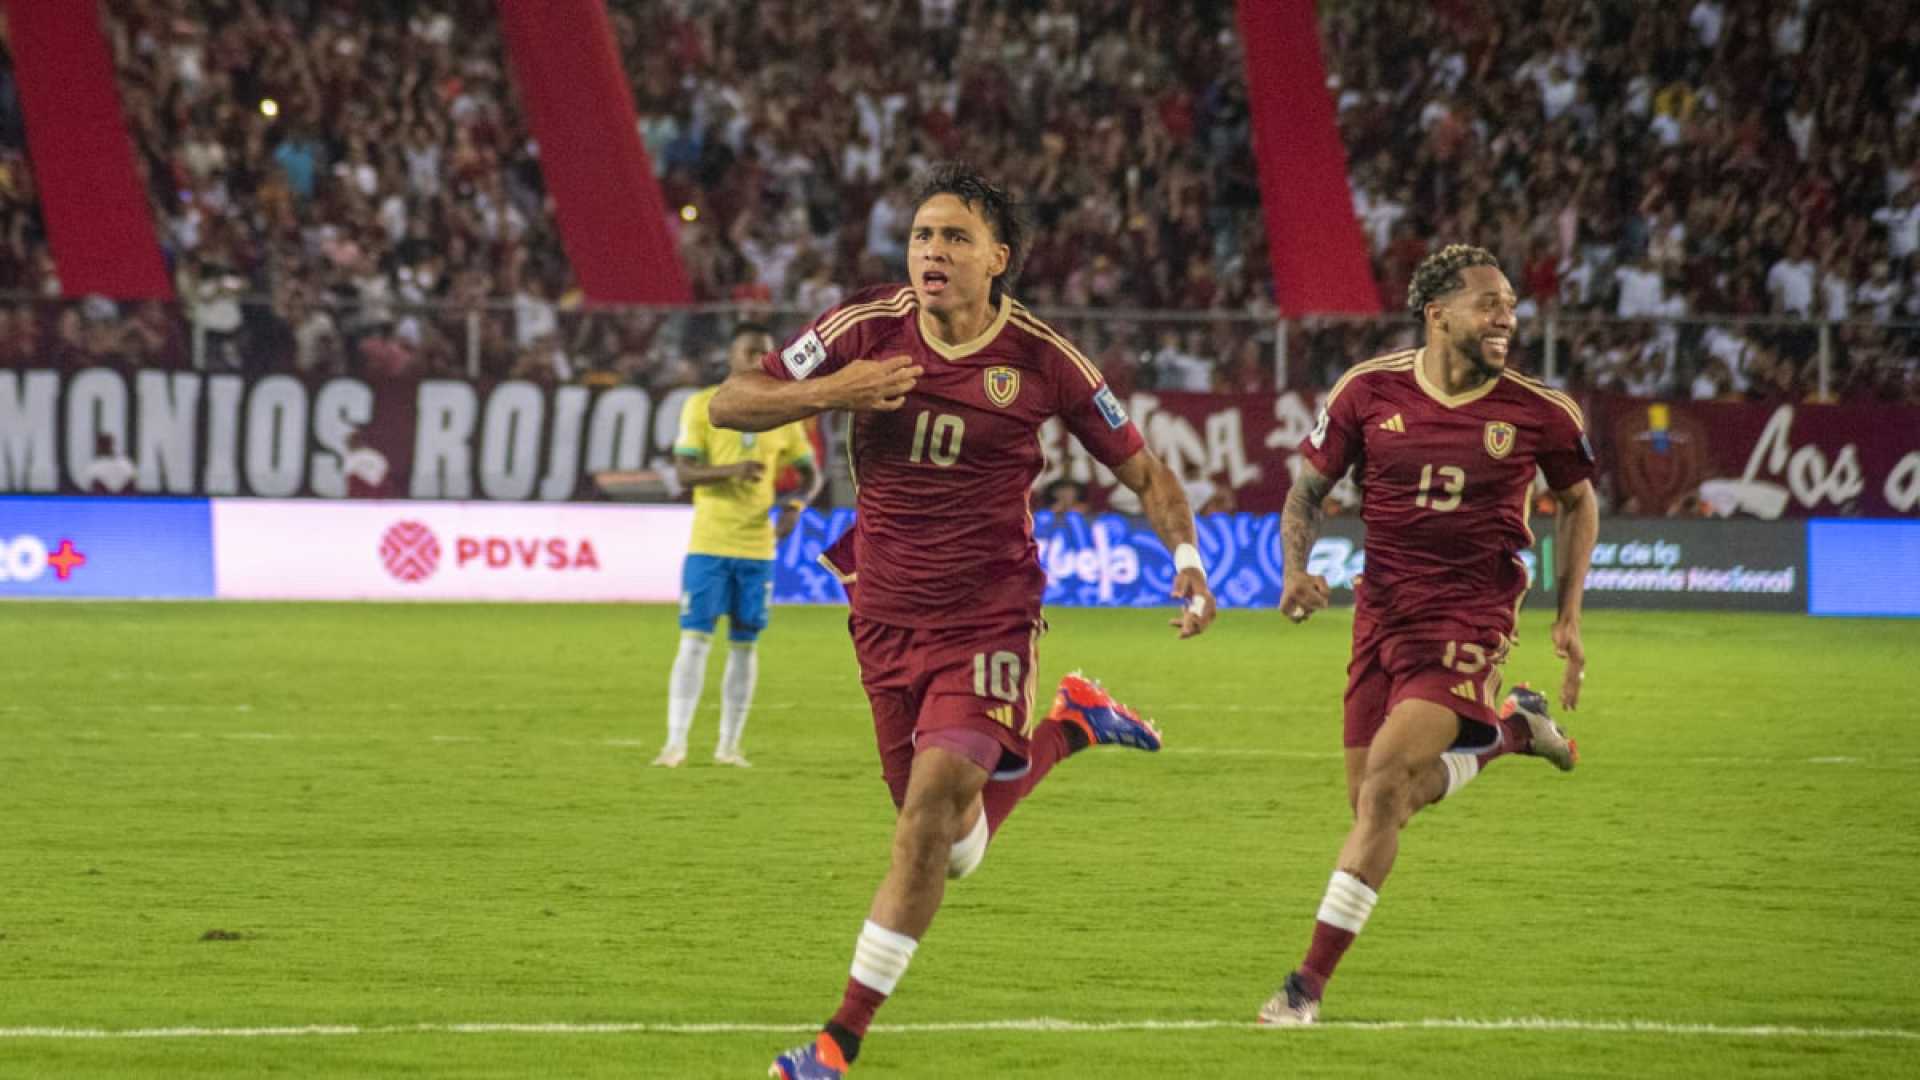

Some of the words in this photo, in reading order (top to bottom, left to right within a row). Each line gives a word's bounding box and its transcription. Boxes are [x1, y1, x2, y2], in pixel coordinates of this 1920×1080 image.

[909, 410, 966, 467] 10
[1700, 404, 1864, 520] Los
[1415, 463, 1465, 512] 13
[455, 537, 599, 571] PDVSA
[1687, 565, 1795, 593] Nacional
[974, 650, 1021, 703] 10
